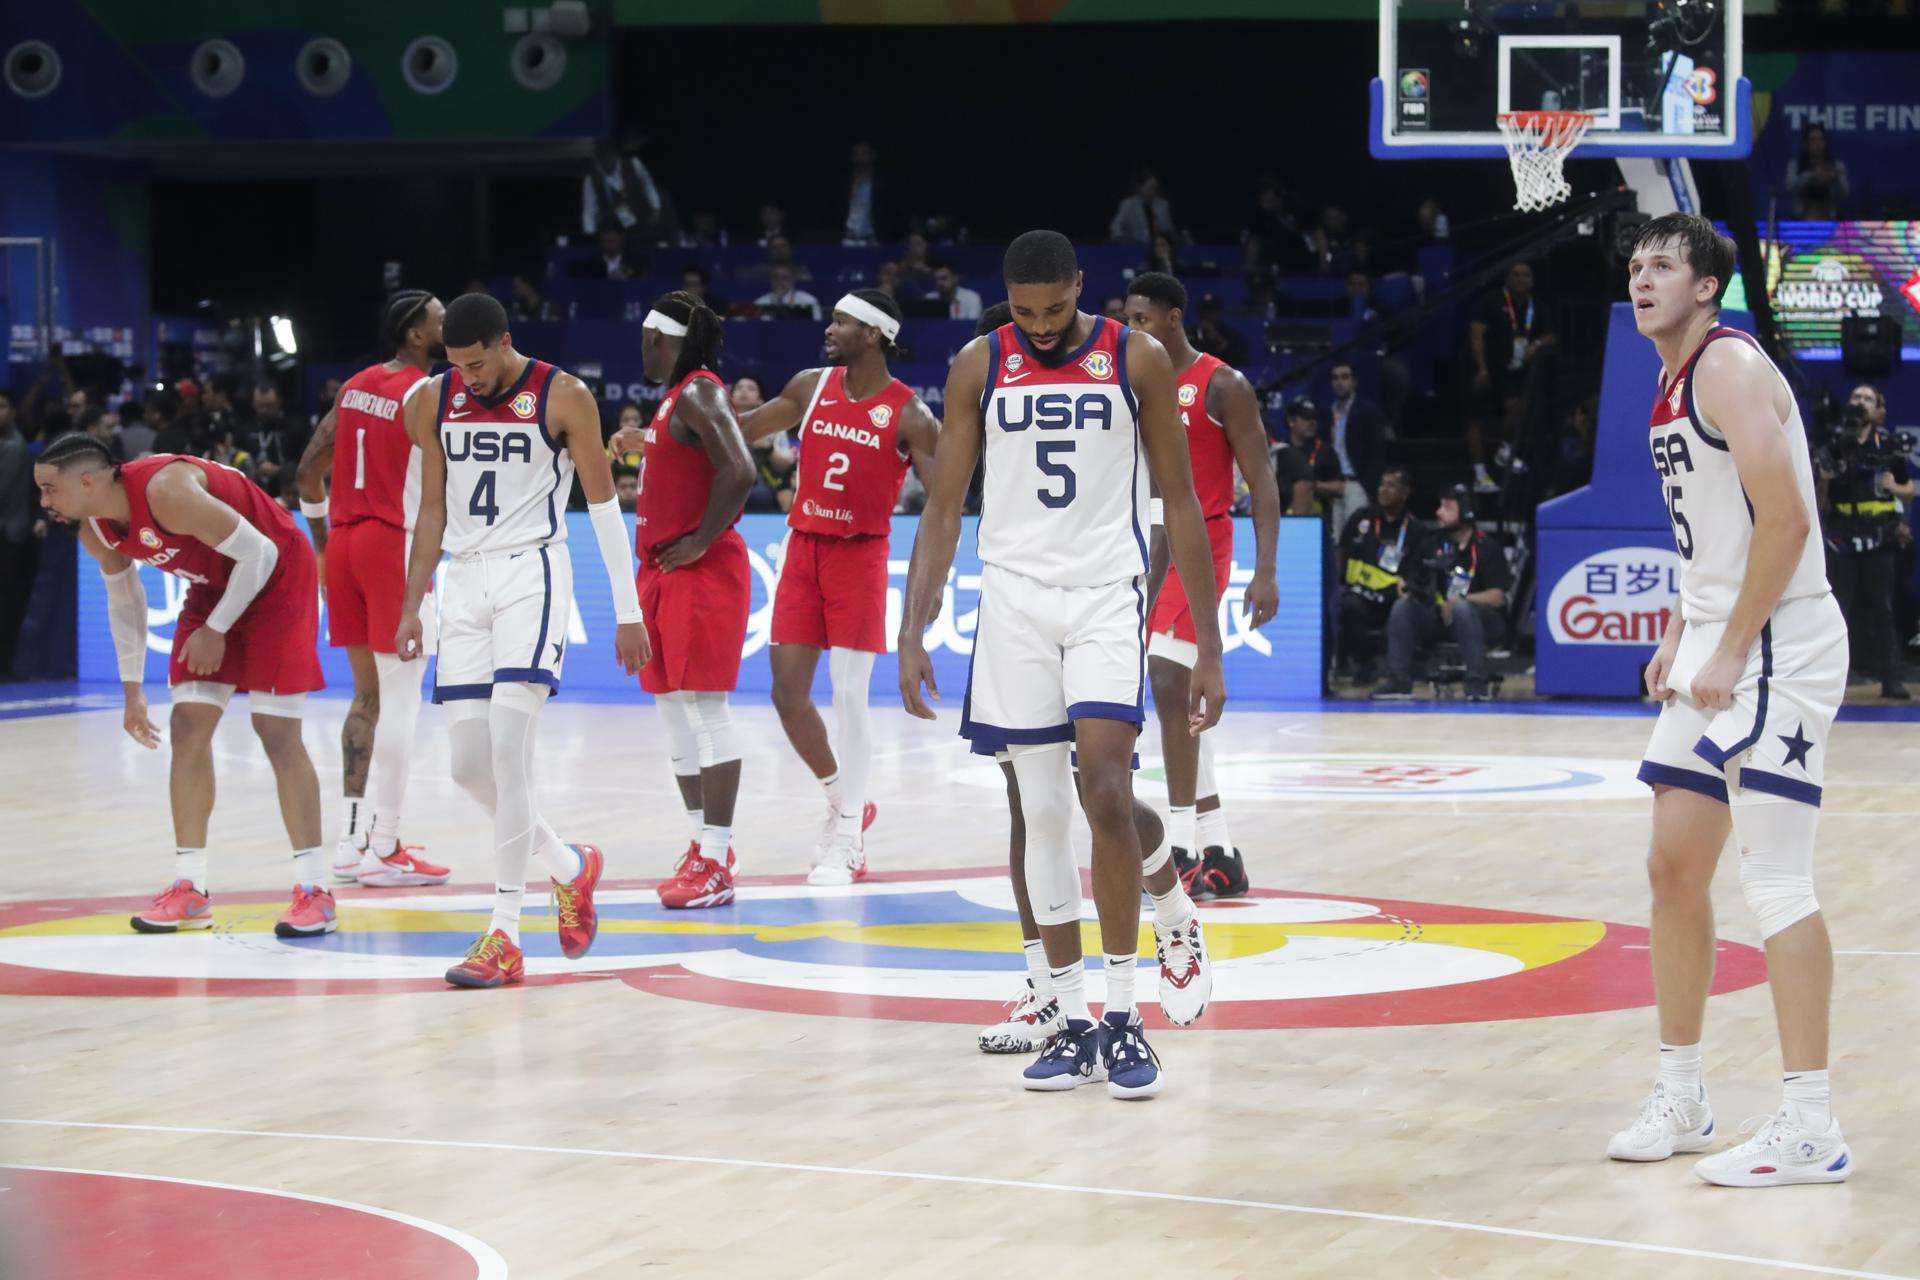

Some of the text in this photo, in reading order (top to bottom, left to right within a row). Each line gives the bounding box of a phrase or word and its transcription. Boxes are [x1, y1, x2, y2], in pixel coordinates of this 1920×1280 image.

[1784, 104, 1857, 131] THE
[1776, 290, 1884, 309] WORLD CUP
[997, 393, 1112, 433] USA
[445, 431, 532, 463] USA
[812, 419, 880, 450] CANADA
[354, 428, 366, 489] 1
[823, 451, 850, 492] 2
[1036, 440, 1076, 508] 5
[468, 470, 499, 526] 4
[815, 505, 834, 519] Sun
